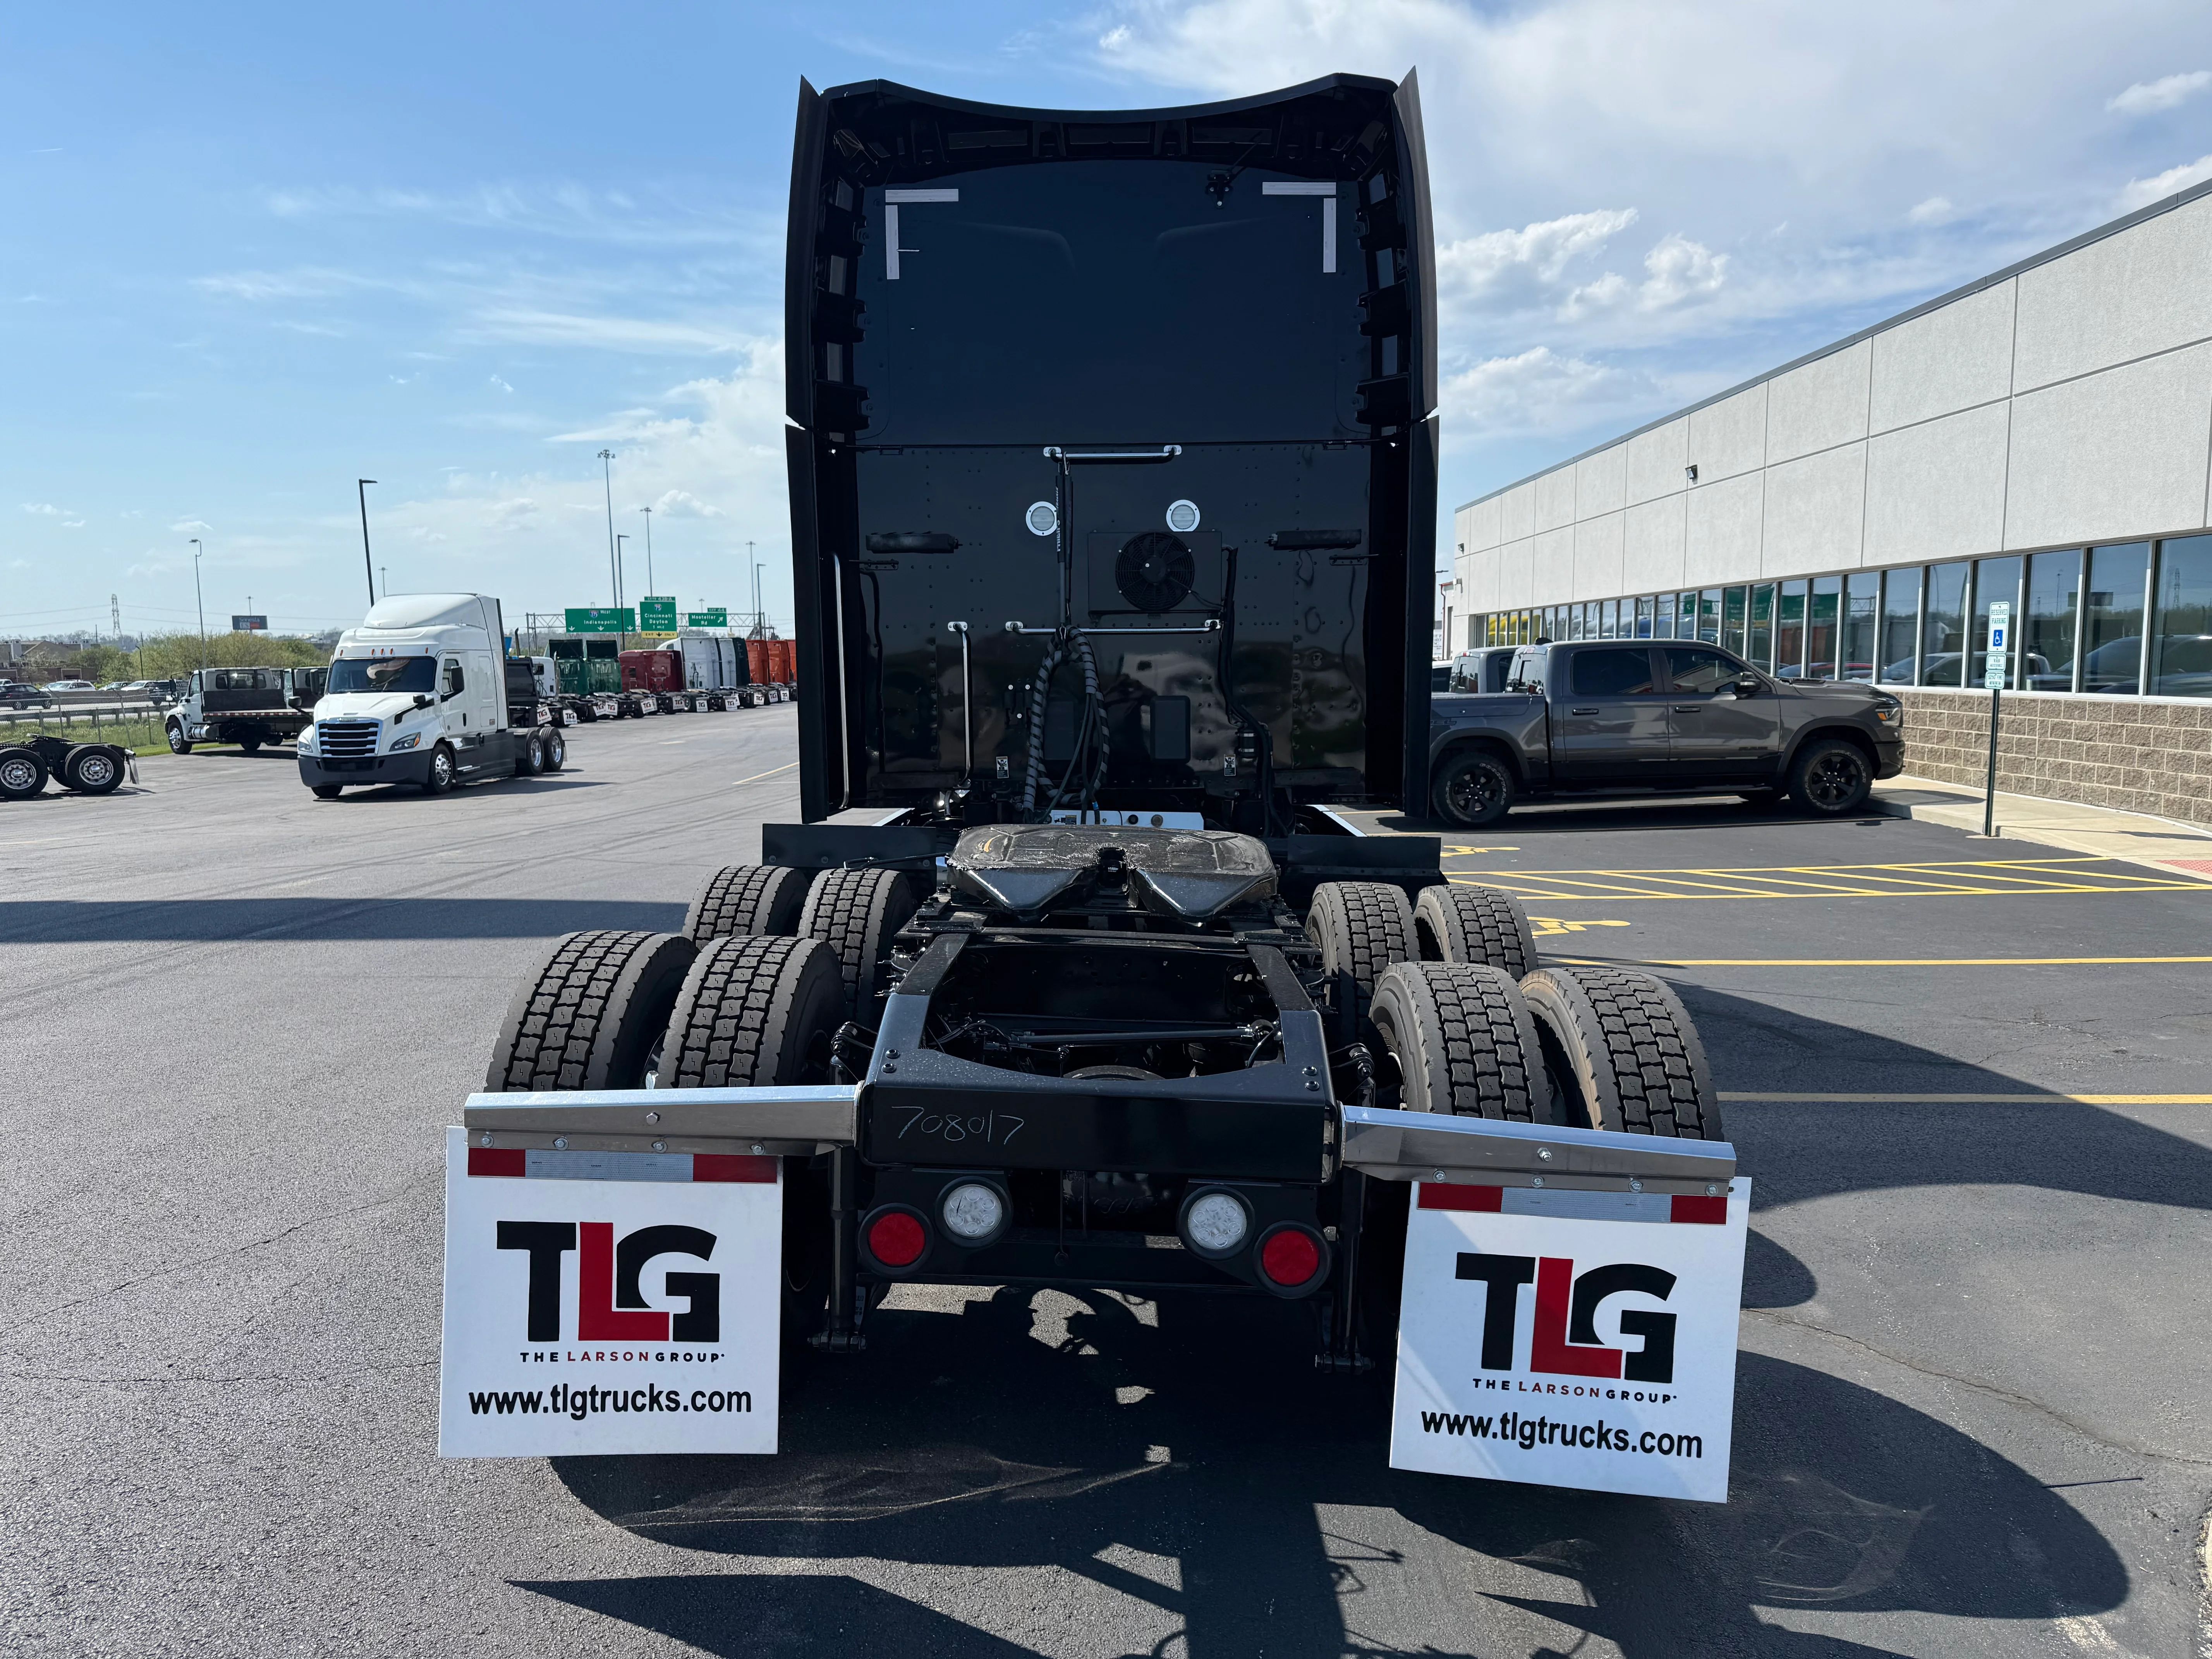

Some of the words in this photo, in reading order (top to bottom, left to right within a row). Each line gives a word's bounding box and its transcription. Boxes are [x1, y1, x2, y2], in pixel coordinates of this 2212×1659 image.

[891, 1106, 1024, 1145] 708017
[497, 1221, 720, 1342] TLG
[1455, 1252, 1678, 1384] TLG
[520, 1352, 558, 1362] THE
[469, 1383, 751, 1420] www.tlgtrucks.com
[1473, 1378, 1510, 1391] THE
[1421, 1411, 1702, 1458] www.tlgtrucks.com
